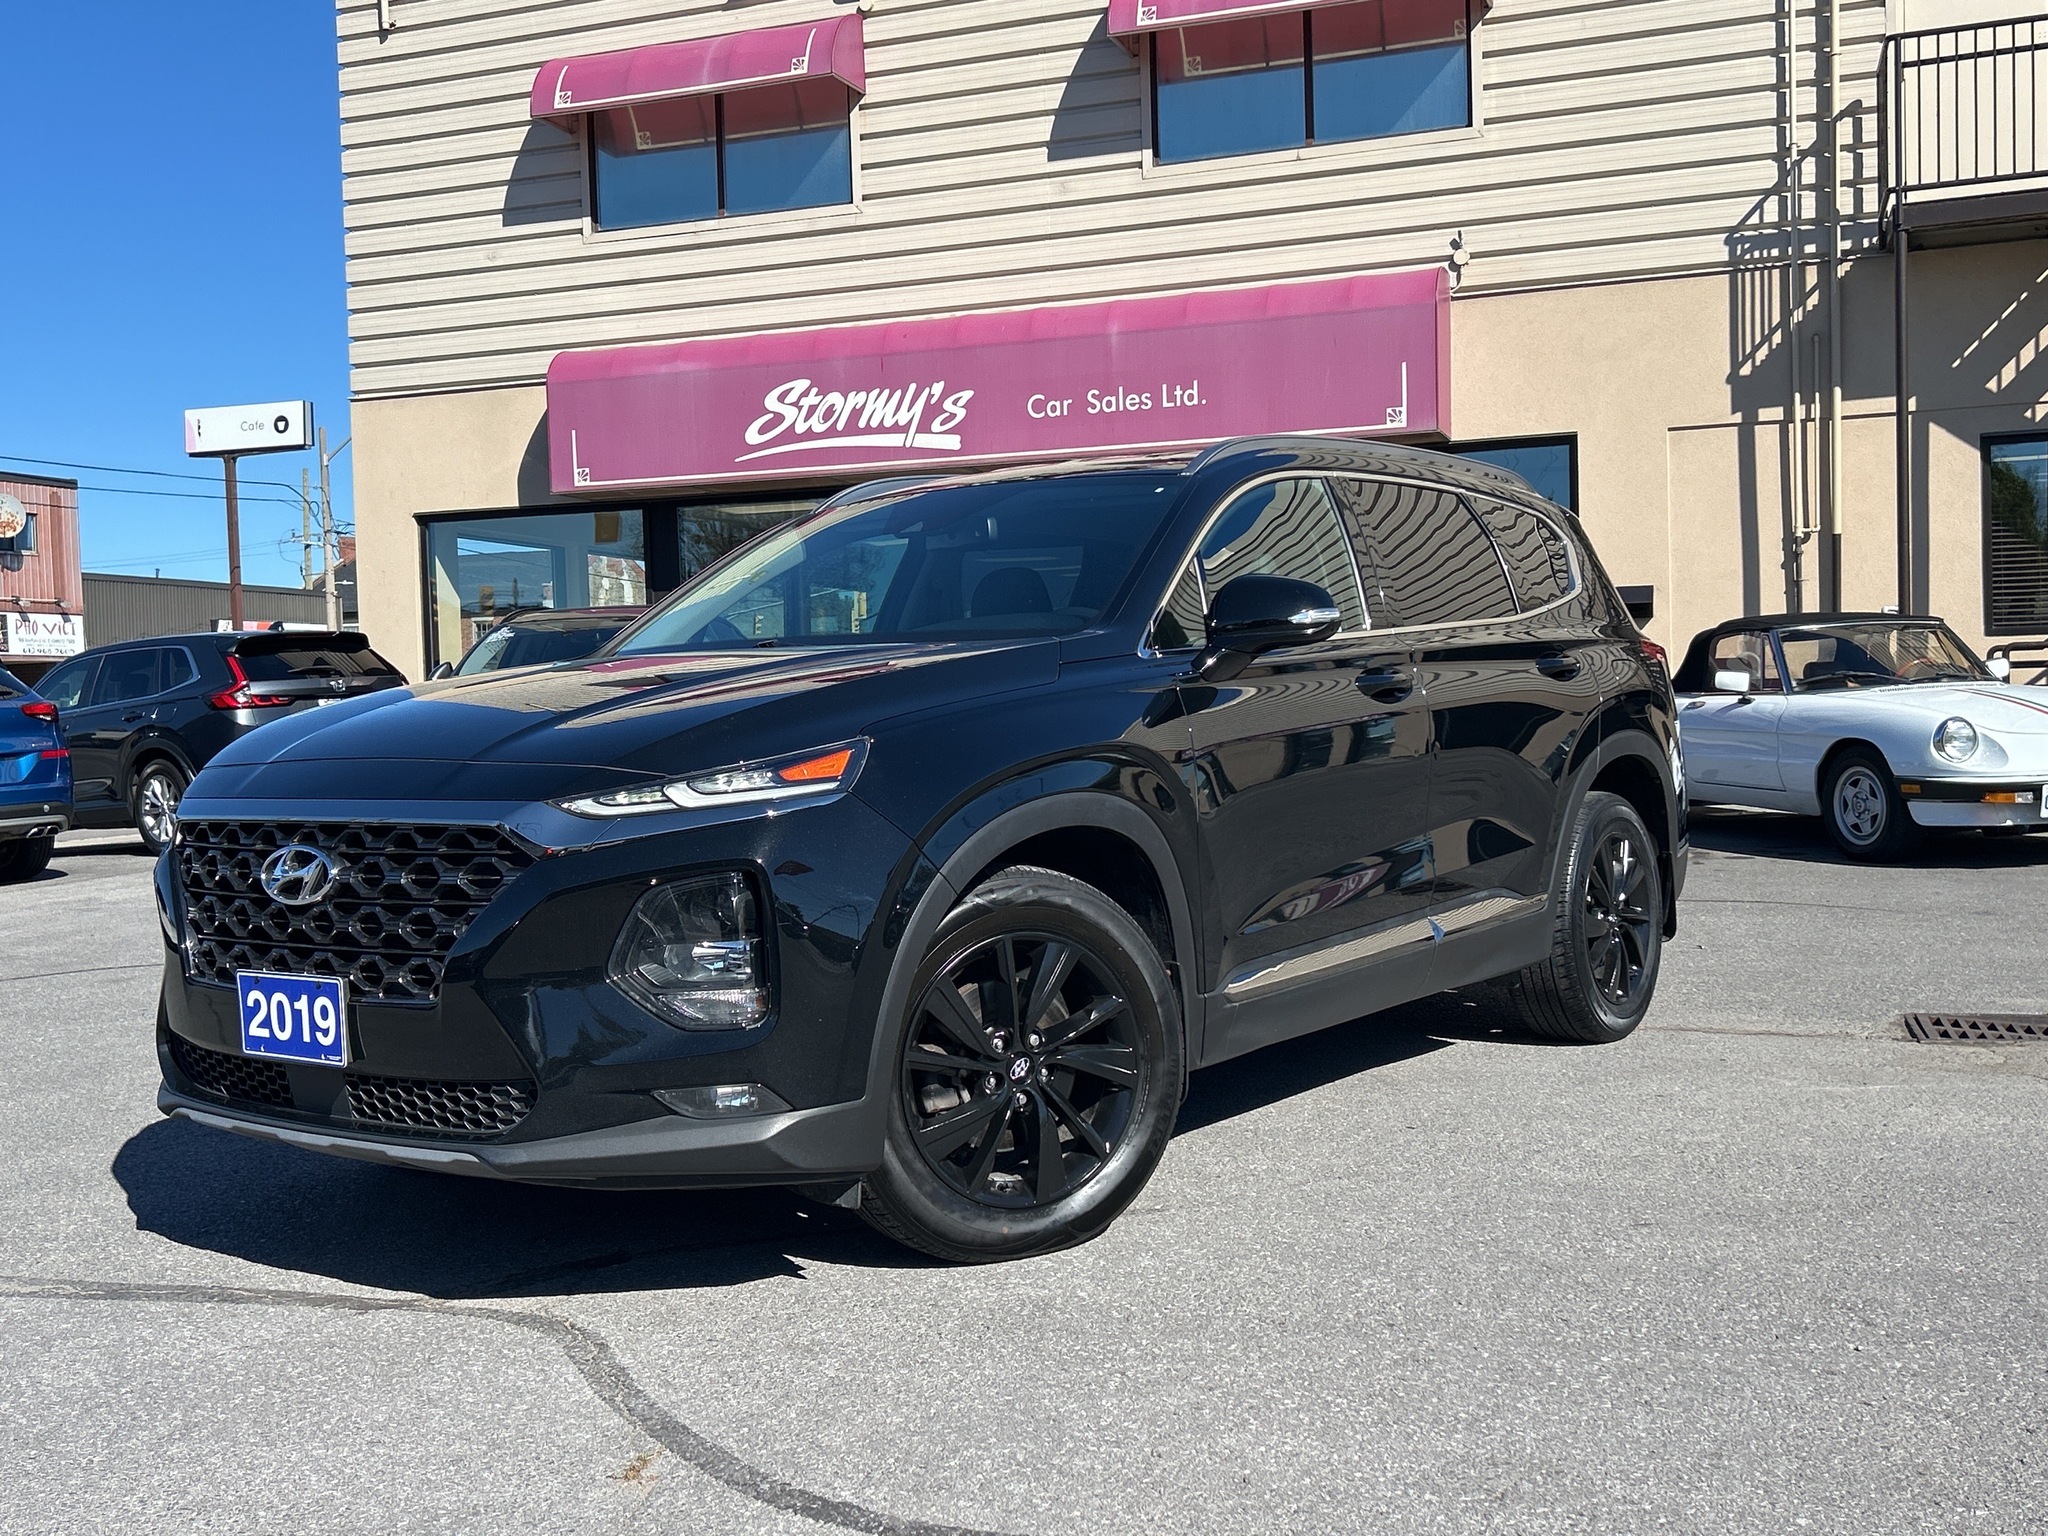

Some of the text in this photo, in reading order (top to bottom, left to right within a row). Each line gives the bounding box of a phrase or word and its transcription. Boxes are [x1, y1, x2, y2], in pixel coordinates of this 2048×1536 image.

[744, 378, 975, 448] Stormy's
[1027, 379, 1207, 419] Car Sales Ltd.
[240, 420, 265, 431] Cafe
[246, 989, 336, 1047] 2019
